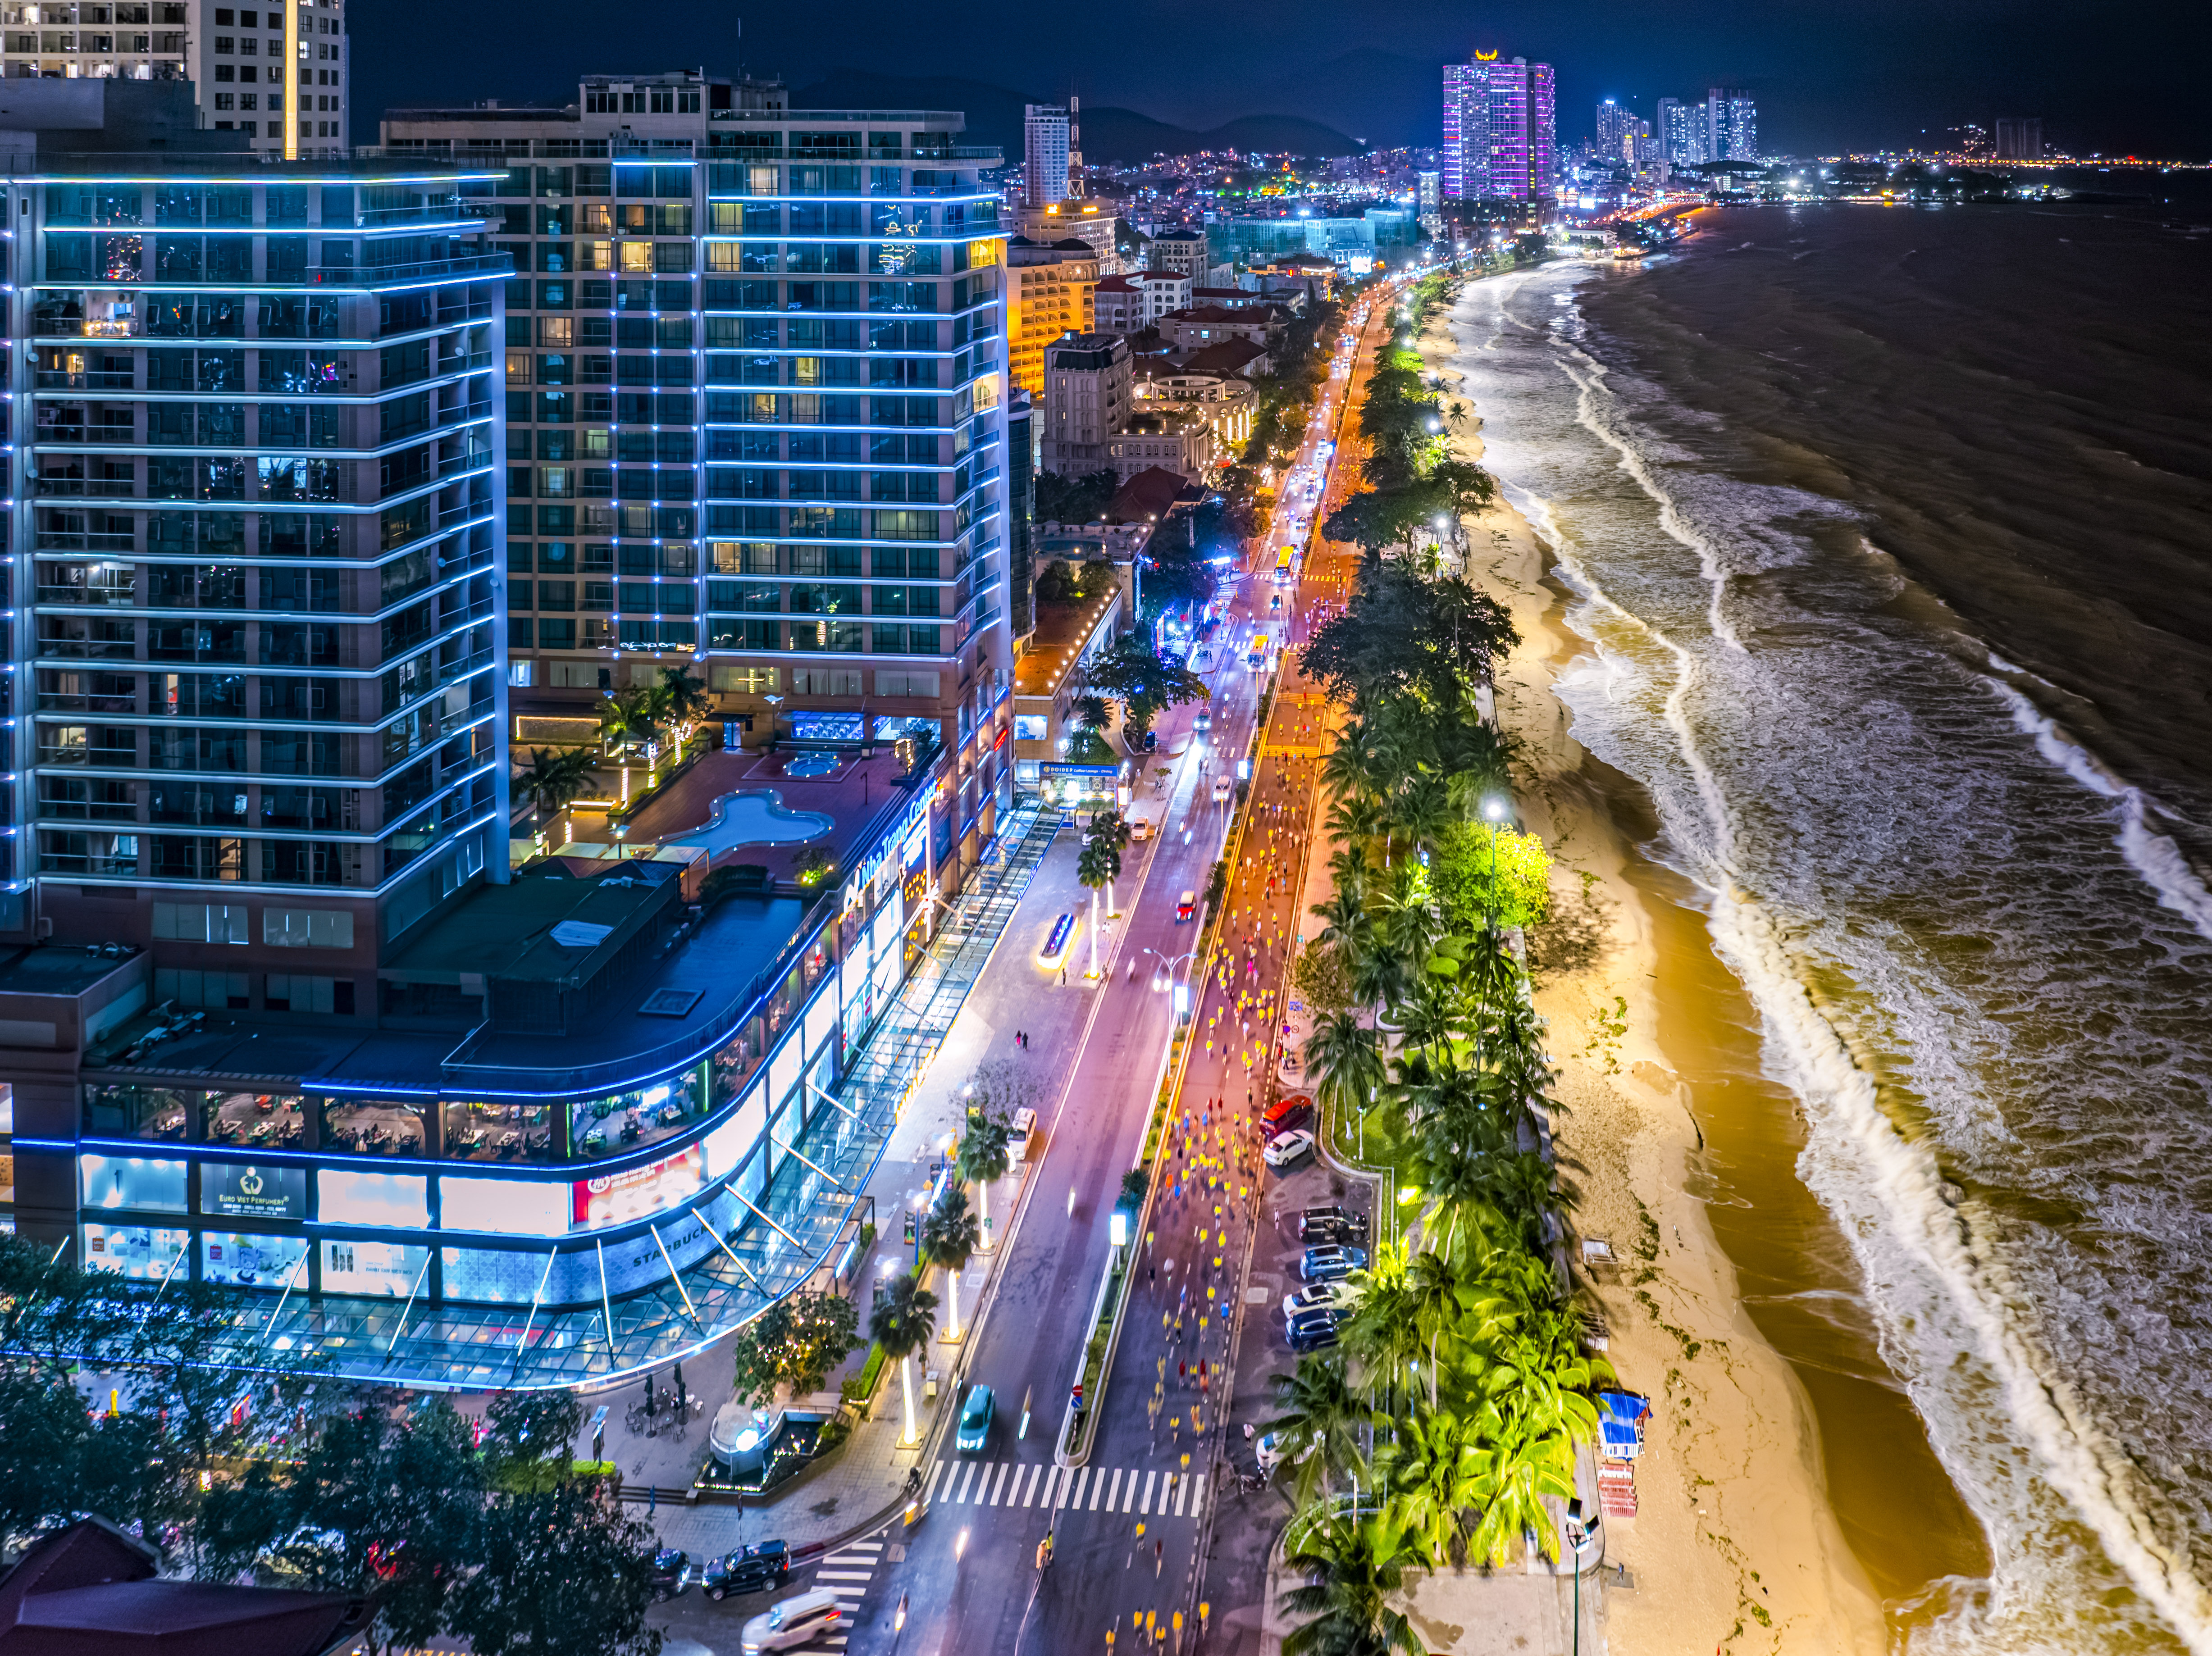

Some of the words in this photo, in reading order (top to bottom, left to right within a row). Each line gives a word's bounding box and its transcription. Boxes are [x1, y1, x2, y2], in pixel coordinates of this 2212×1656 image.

[862, 851, 882, 889] Nha
[882, 816, 908, 858] Trang
[909, 778, 938, 823] Center
[633, 1218, 715, 1267] STARBUCKS
